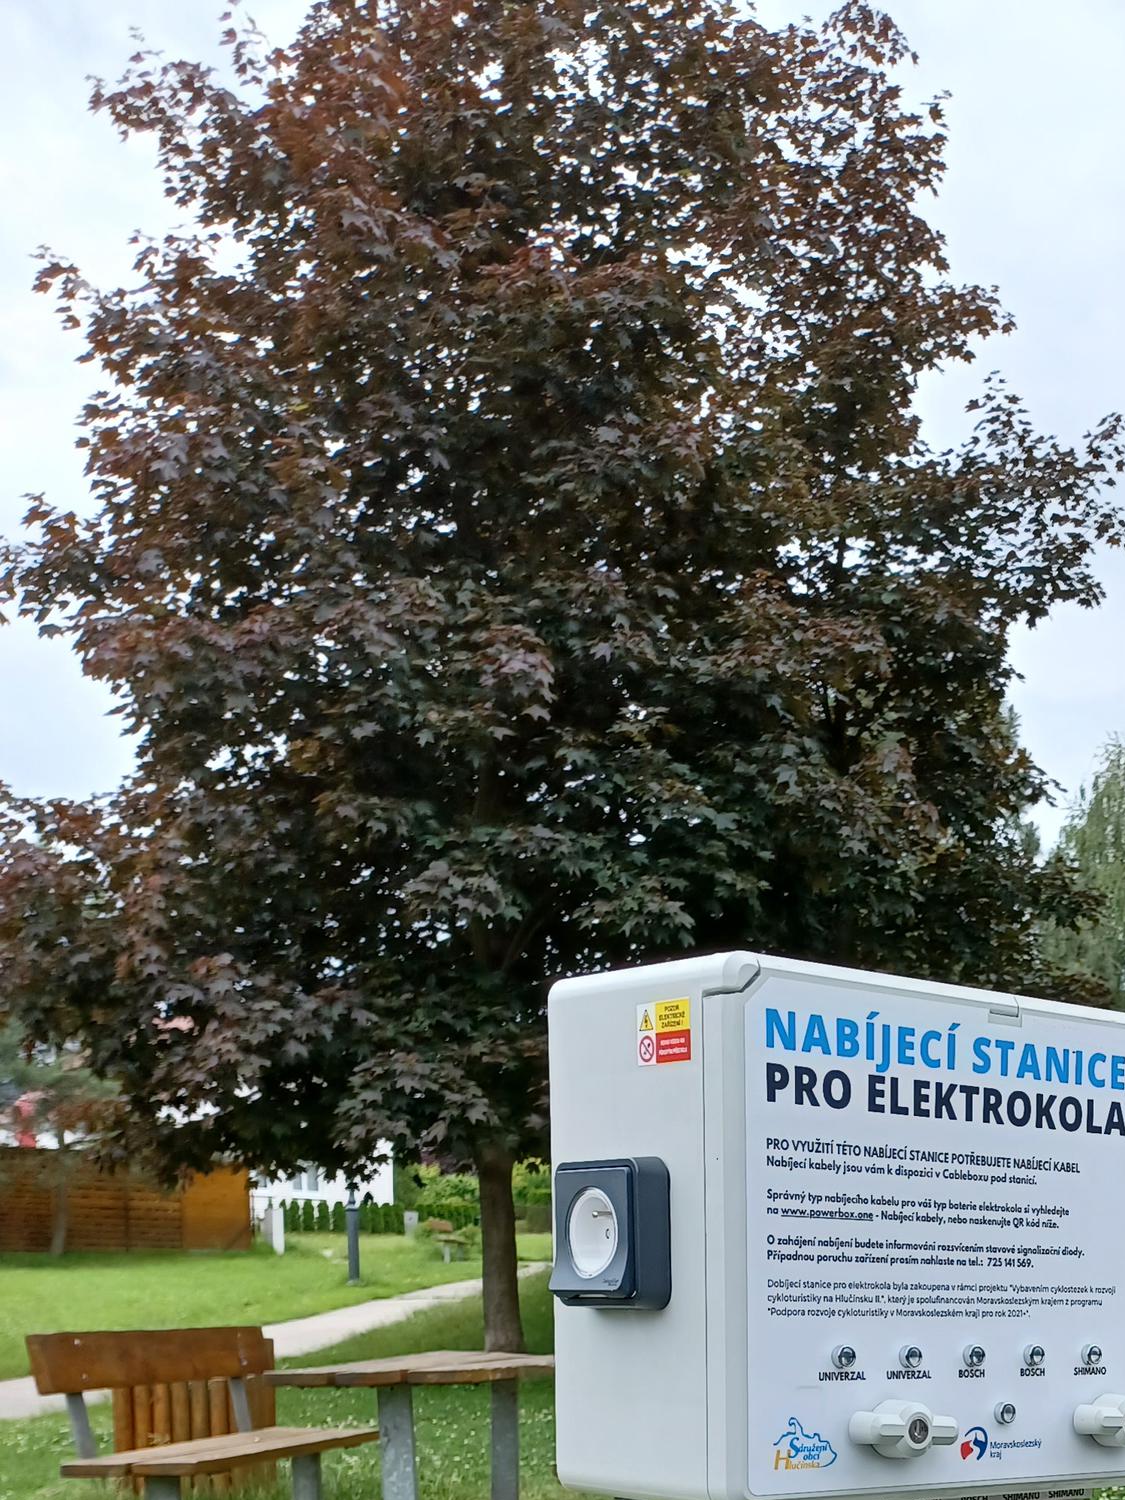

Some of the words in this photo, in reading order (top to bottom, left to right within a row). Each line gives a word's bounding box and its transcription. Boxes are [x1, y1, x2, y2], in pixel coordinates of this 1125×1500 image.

[766, 1008, 960, 1072] NABÍJECÍ
[972, 1037, 1125, 1090] STANICE
[766, 1062, 851, 1109] PRO
[766, 1138, 789, 1150] PRO
[792, 1138, 834, 1154] VYUŽITÍ
[836, 1141, 861, 1156] TÉTO
[864, 1144, 907, 1160] NABÍJECÍ
[909, 1150, 949, 1164] STANICE
[951, 1151, 1011, 1168] POTŘEBUJETE
[1013, 1156, 1051, 1171] NABÍJECÍ
[1053, 1161, 1080, 1173] KABEL
[766, 1156, 807, 1171] Nabíjecí
[808, 1158, 841, 1174] kabely
[843, 1161, 862, 1174] jsou
[864, 1163, 885, 1174] vám
[887, 1164, 893, 1175] k
[895, 1165, 933, 1179] dispozici
[935, 1170, 940, 1178] v
[943, 1169, 988, 1182] Cableboxu
[990, 1173, 1006, 1184] pod
[1008, 1175, 1037, 1185] stanicí.
[766, 1188, 806, 1204] Správný
[808, 1192, 822, 1204] typ
[824, 1192, 868, 1206] nabíjecího
[871, 1195, 900, 1206] kabelu
[902, 1198, 916, 1209] pro
[918, 1199, 932, 1208] váš
[934, 1200, 947, 1211] typ
[948, 1199, 977, 1210] baterie
[978, 1202, 1022, 1213] elektrokola
[1024, 1204, 1030, 1214] si
[1032, 1205, 1070, 1218] vyhledejte
[766, 1206, 779, 1214] na
[781, 1208, 874, 1220] www.powerbox.one
[881, 1210, 914, 1224] Nabíjecí
[916, 1212, 946, 1225] kabely,
[948, 1214, 968, 1224] nebo
[969, 1215, 1010, 1228] naskenujte
[1012, 1218, 1024, 1228] QR
[1026, 1218, 1040, 1228] kód
[1042, 1220, 1059, 1228] níže.
[766, 1234, 775, 1244] O
[778, 1235, 816, 1248] zahájení
[818, 1236, 853, 1250] nabíjení
[854, 1238, 884, 1249] budete
[938, 1242, 984, 1253] rozsvícením
[986, 1244, 1016, 1254] stavové
[1062, 1246, 1084, 1258] diody.
[766, 1250, 814, 1263] Případnou
[817, 1252, 852, 1264] poruchu
[854, 1254, 888, 1264] zařízení
[890, 1256, 918, 1266] prosím
[920, 1256, 955, 1266] nahlaste
[987, 1258, 1002, 1267] 725
[1004, 1258, 1015, 1268] 141
[1017, 1258, 1034, 1268] 569.
[768, 1279, 801, 1290] Dobíjecí
[803, 1280, 832, 1289] stanice
[833, 1282, 846, 1290] pro
[848, 1281, 891, 1290] elektrokola
[892, 1281, 908, 1292] byla
[910, 1282, 950, 1292] zakoupena
[957, 1284, 977, 1292] rámci
[978, 1284, 1008, 1293] projektu
[1050, 1285, 1088, 1294] cyklostezek
[1095, 1286, 1116, 1295] rozvoji
[768, 1294, 821, 1304] cykloturistiky
[835, 1294, 873, 1303] Hlučínsku
[888, 1294, 906, 1304] který
[907, 1296, 914, 1305] je
[916, 1296, 975, 1306] spolufinancován
[976, 1296, 1039, 1306] Moravskoslezským
[1040, 1298, 1064, 1306] krajem
[808, 1308, 836, 1317] rozvoje
[838, 1308, 888, 1318] cykloturistiky
[896, 1308, 964, 1318] Moravskoslezském
[994, 1309, 1006, 1317] rok
[818, 1371, 866, 1382] UNIVERZAL
[886, 1370, 932, 1380] UNIVERZAL
[958, 1369, 985, 1378] BOSCH
[1020, 1368, 1045, 1376] BOSCH
[1074, 1366, 1106, 1376] SHIMANO
[990, 1439, 1042, 1450] Moravskoslezský
[990, 1450, 1002, 1460] kraj
[1048, 1488, 1084, 1499] SHIMANO
